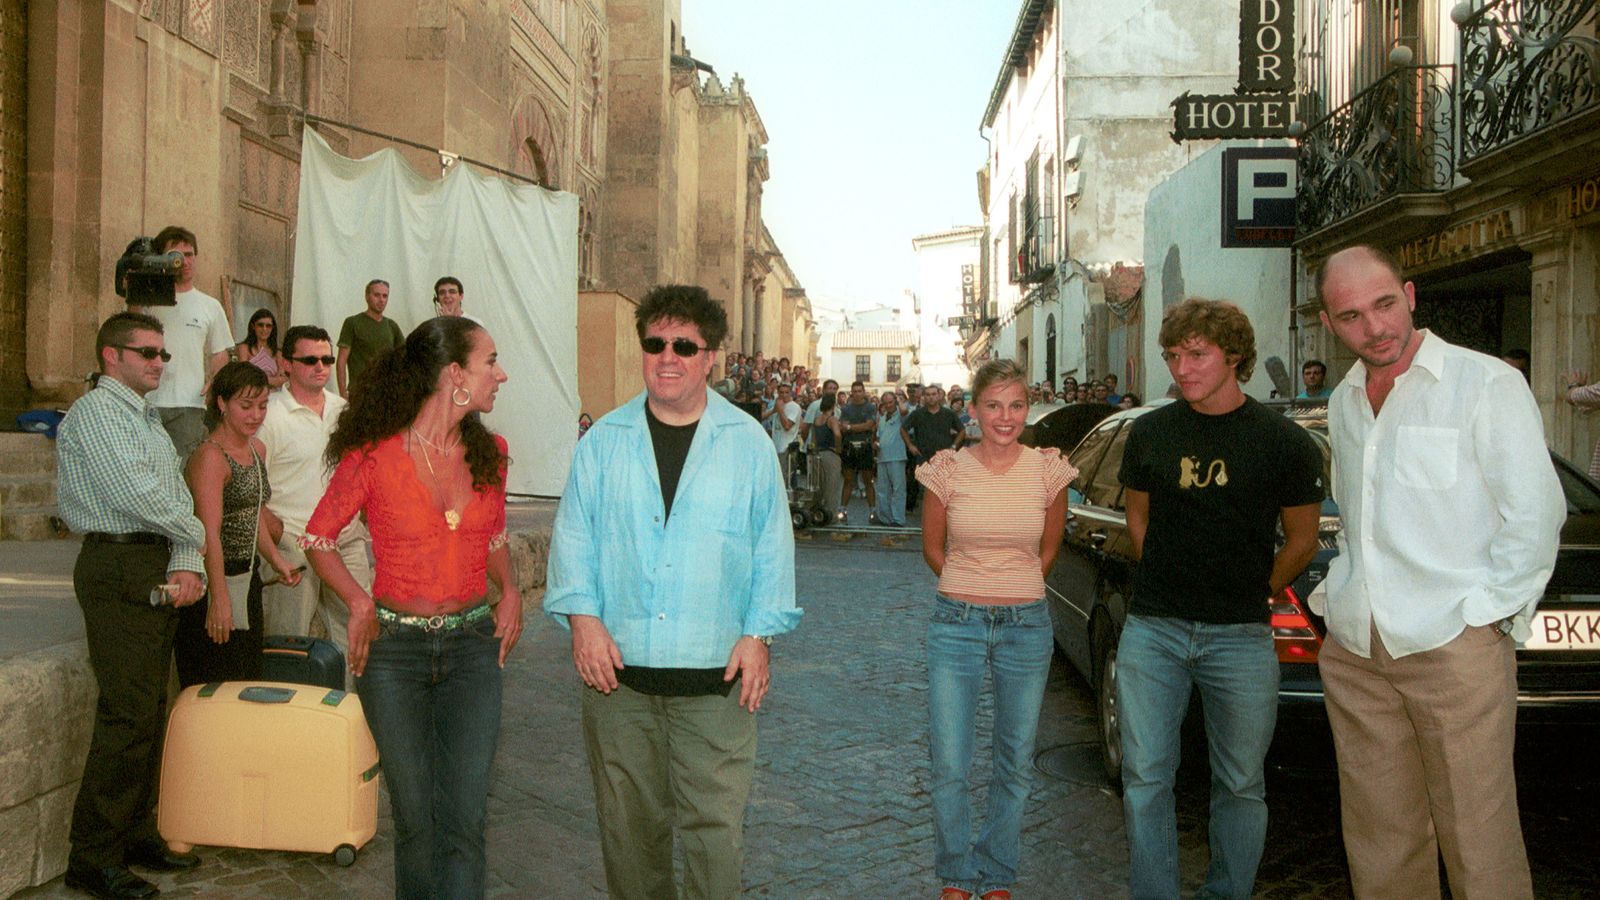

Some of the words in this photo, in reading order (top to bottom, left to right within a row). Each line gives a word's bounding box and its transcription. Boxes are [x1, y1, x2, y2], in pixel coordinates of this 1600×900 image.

[1257, 0, 1281, 80] DOR
[1237, 159, 1296, 220] P
[1568, 178, 1600, 217] HO
[962, 265, 973, 314] HOTEL
[1543, 613, 1600, 644] BKK
